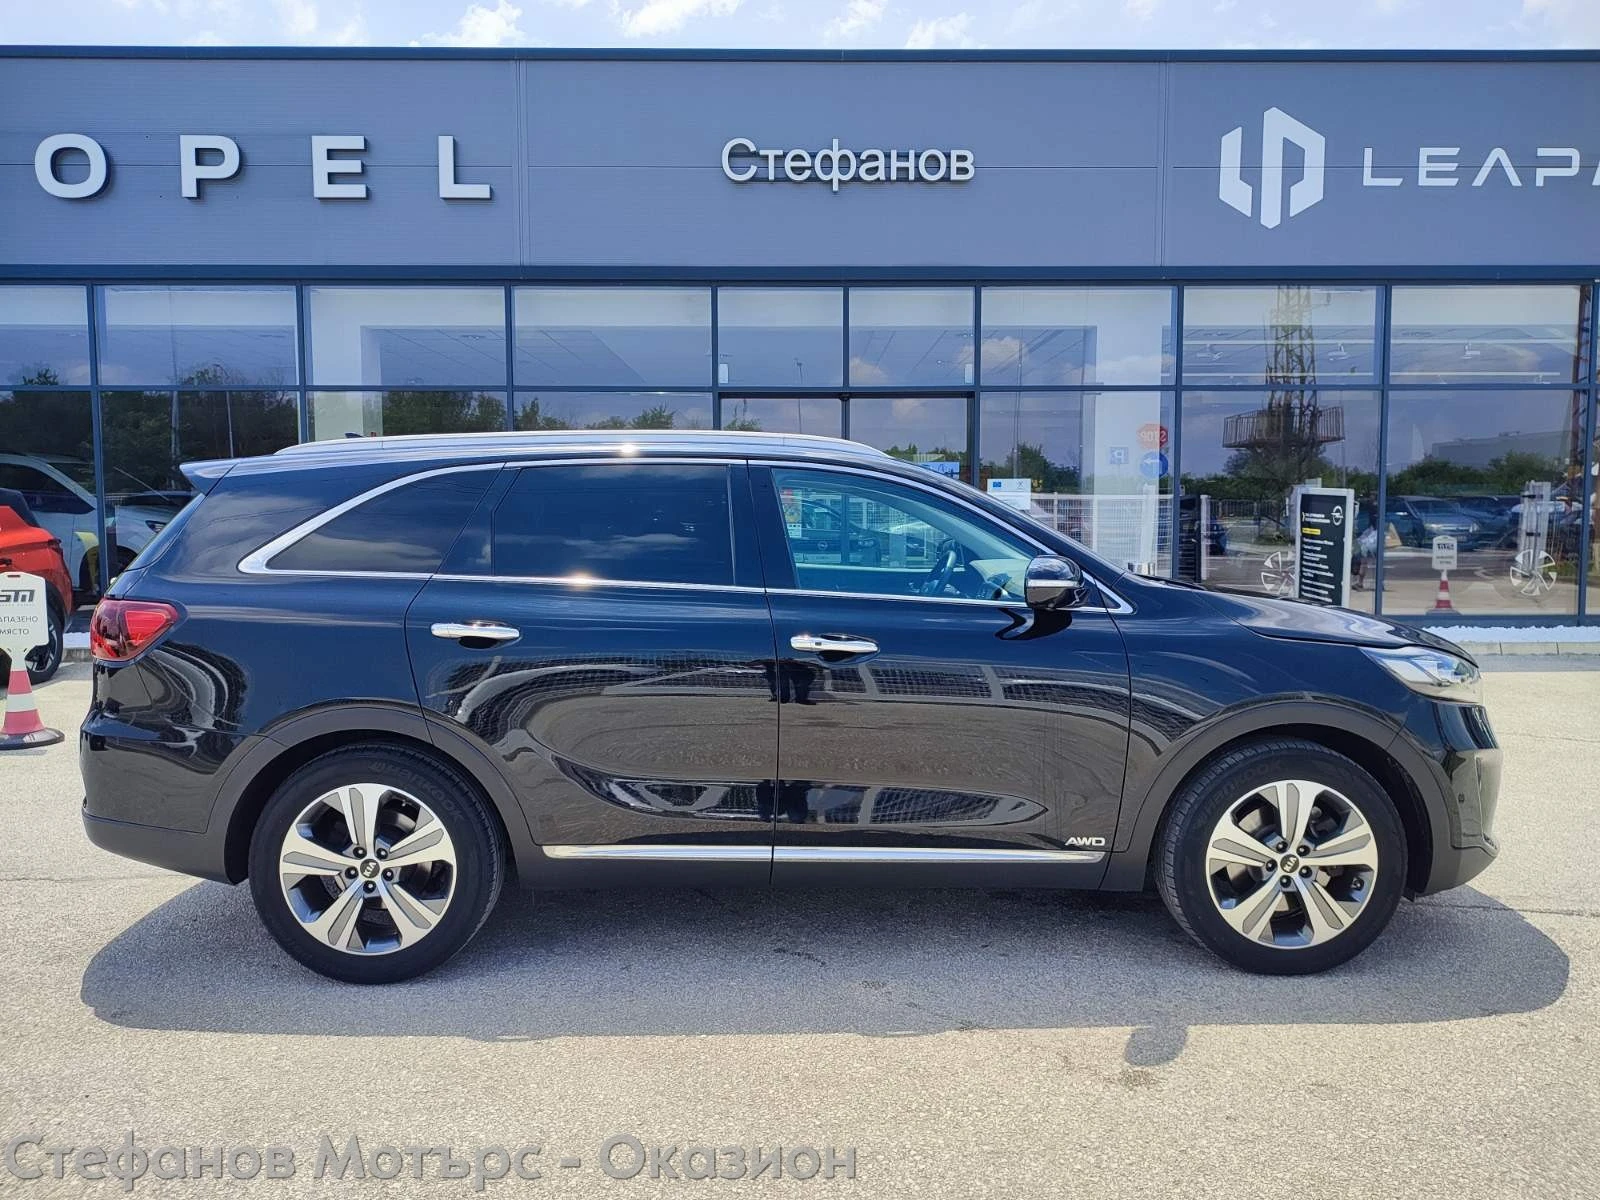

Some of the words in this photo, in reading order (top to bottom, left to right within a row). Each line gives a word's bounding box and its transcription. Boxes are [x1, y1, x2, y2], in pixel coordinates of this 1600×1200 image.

[34, 133, 494, 201] OPEL
[721, 137, 976, 193] Стефанов
[1362, 147, 1600, 187] LEAP
[1064, 836, 1106, 846] AWD
